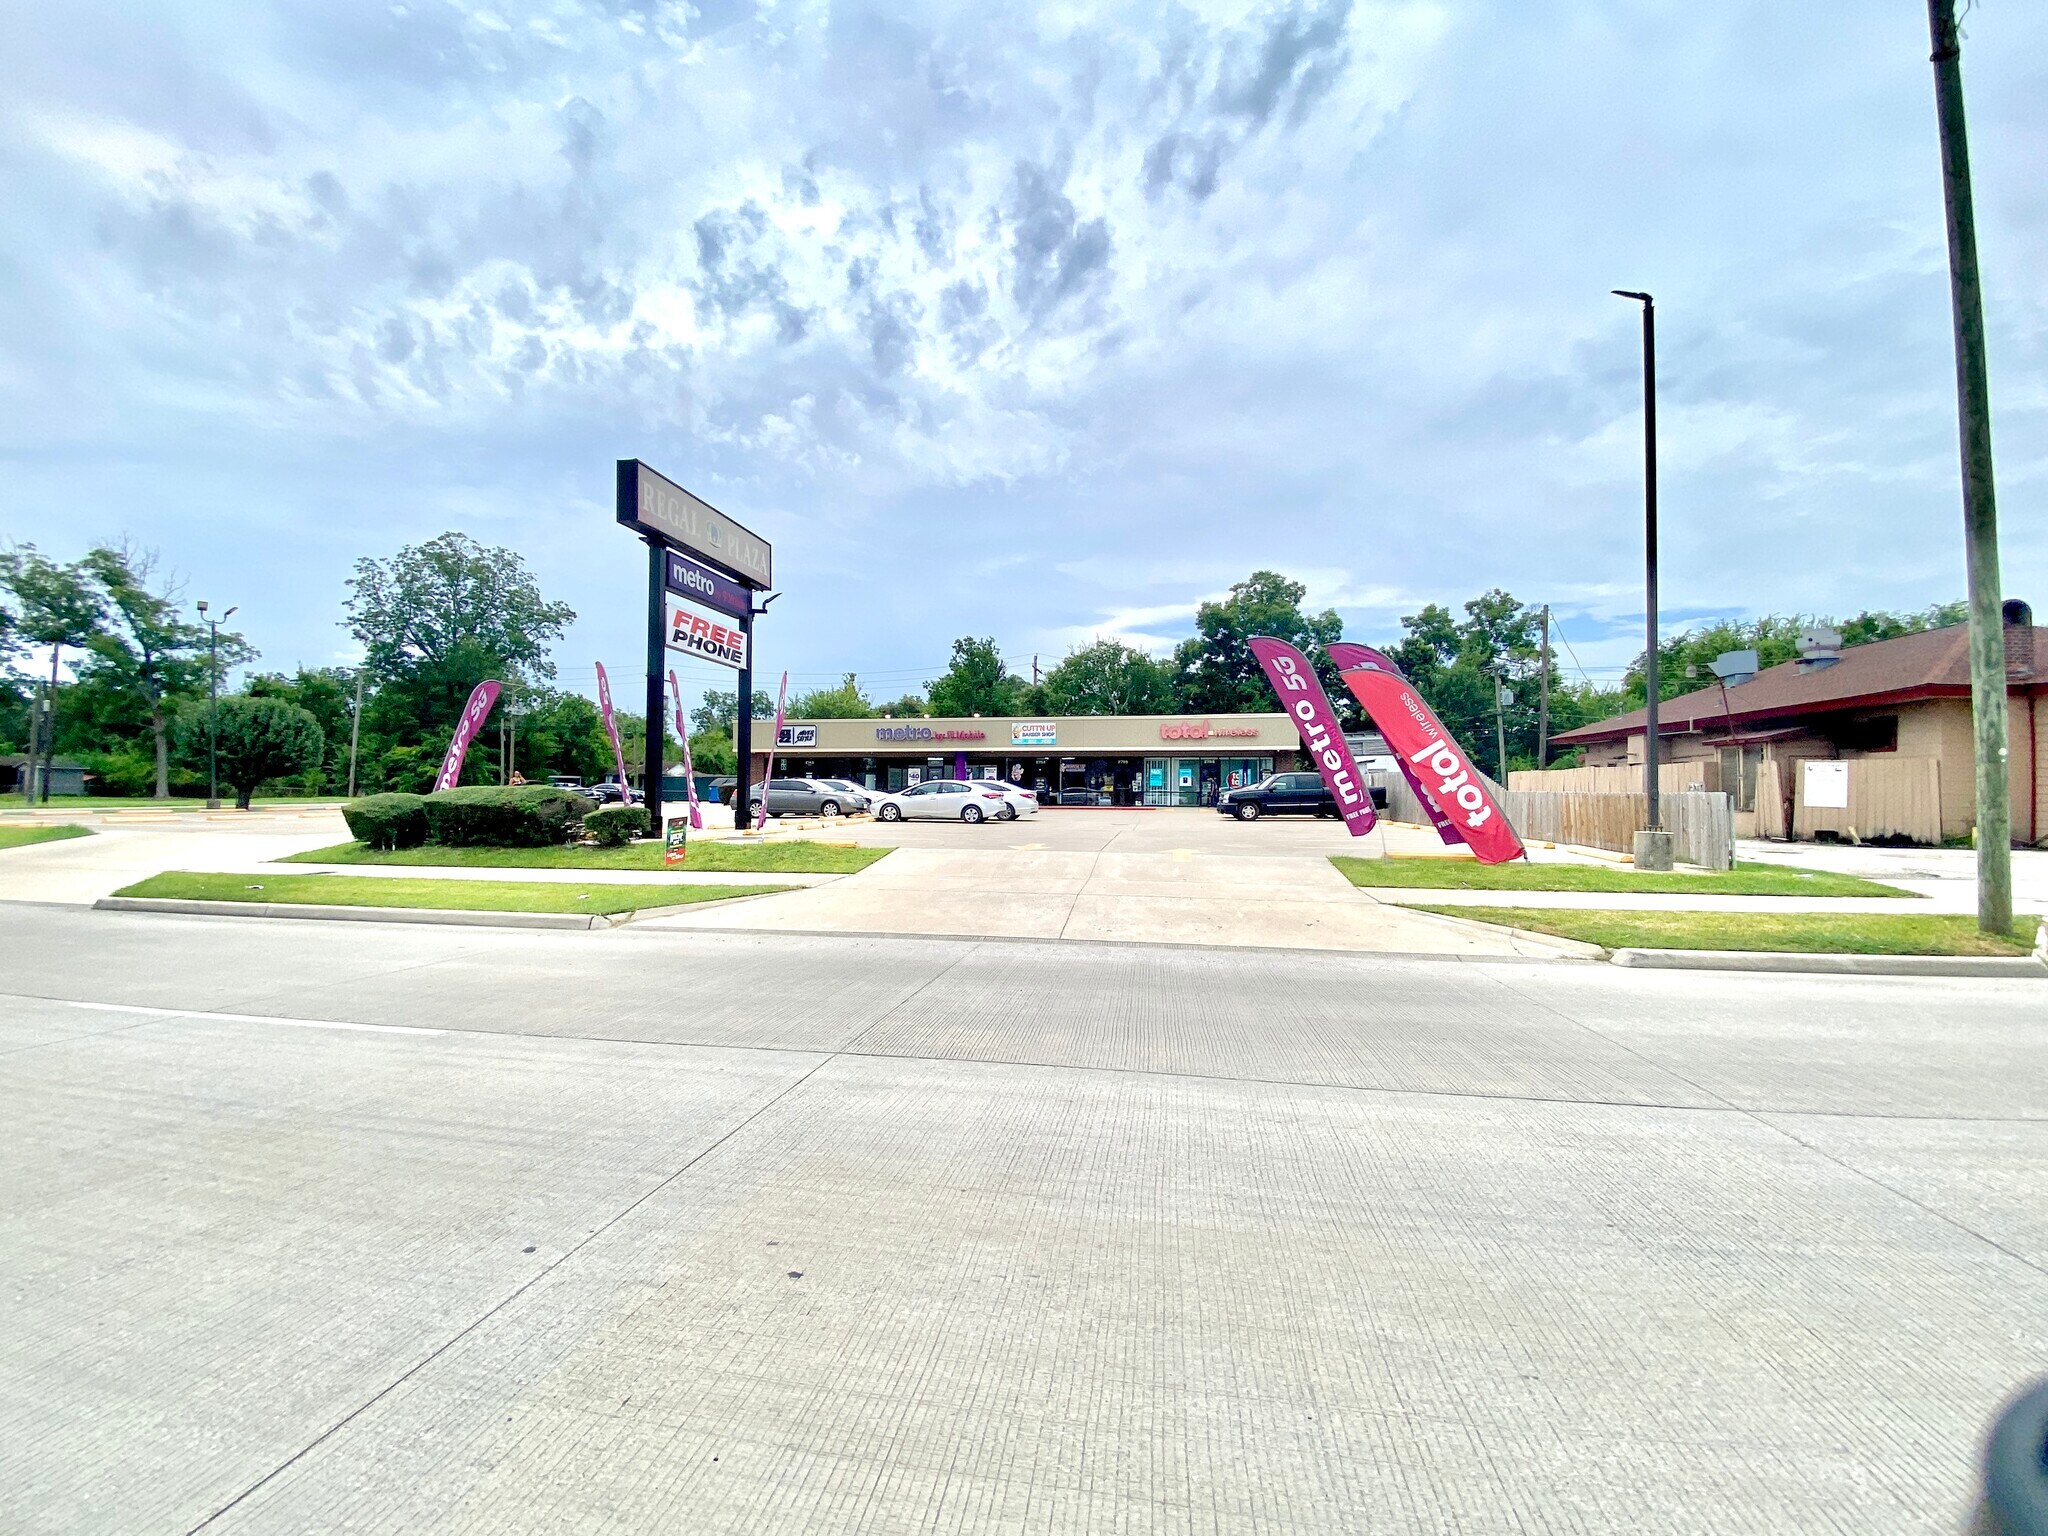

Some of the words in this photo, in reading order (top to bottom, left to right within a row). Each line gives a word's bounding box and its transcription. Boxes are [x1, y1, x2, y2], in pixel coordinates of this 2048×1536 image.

[642, 482, 701, 539] REGAL
[727, 533, 769, 577] PLAZA
[673, 563, 715, 596] metro
[672, 628, 743, 664] PHONE
[673, 609, 744, 651] FREE
[1271, 655, 1309, 691] 5G
[876, 724, 932, 742] metro
[1160, 719, 1210, 740] total
[1214, 727, 1260, 738] wireless
[1399, 691, 1437, 740] wireless
[1295, 699, 1358, 805] metro
[1410, 738, 1492, 828] total
